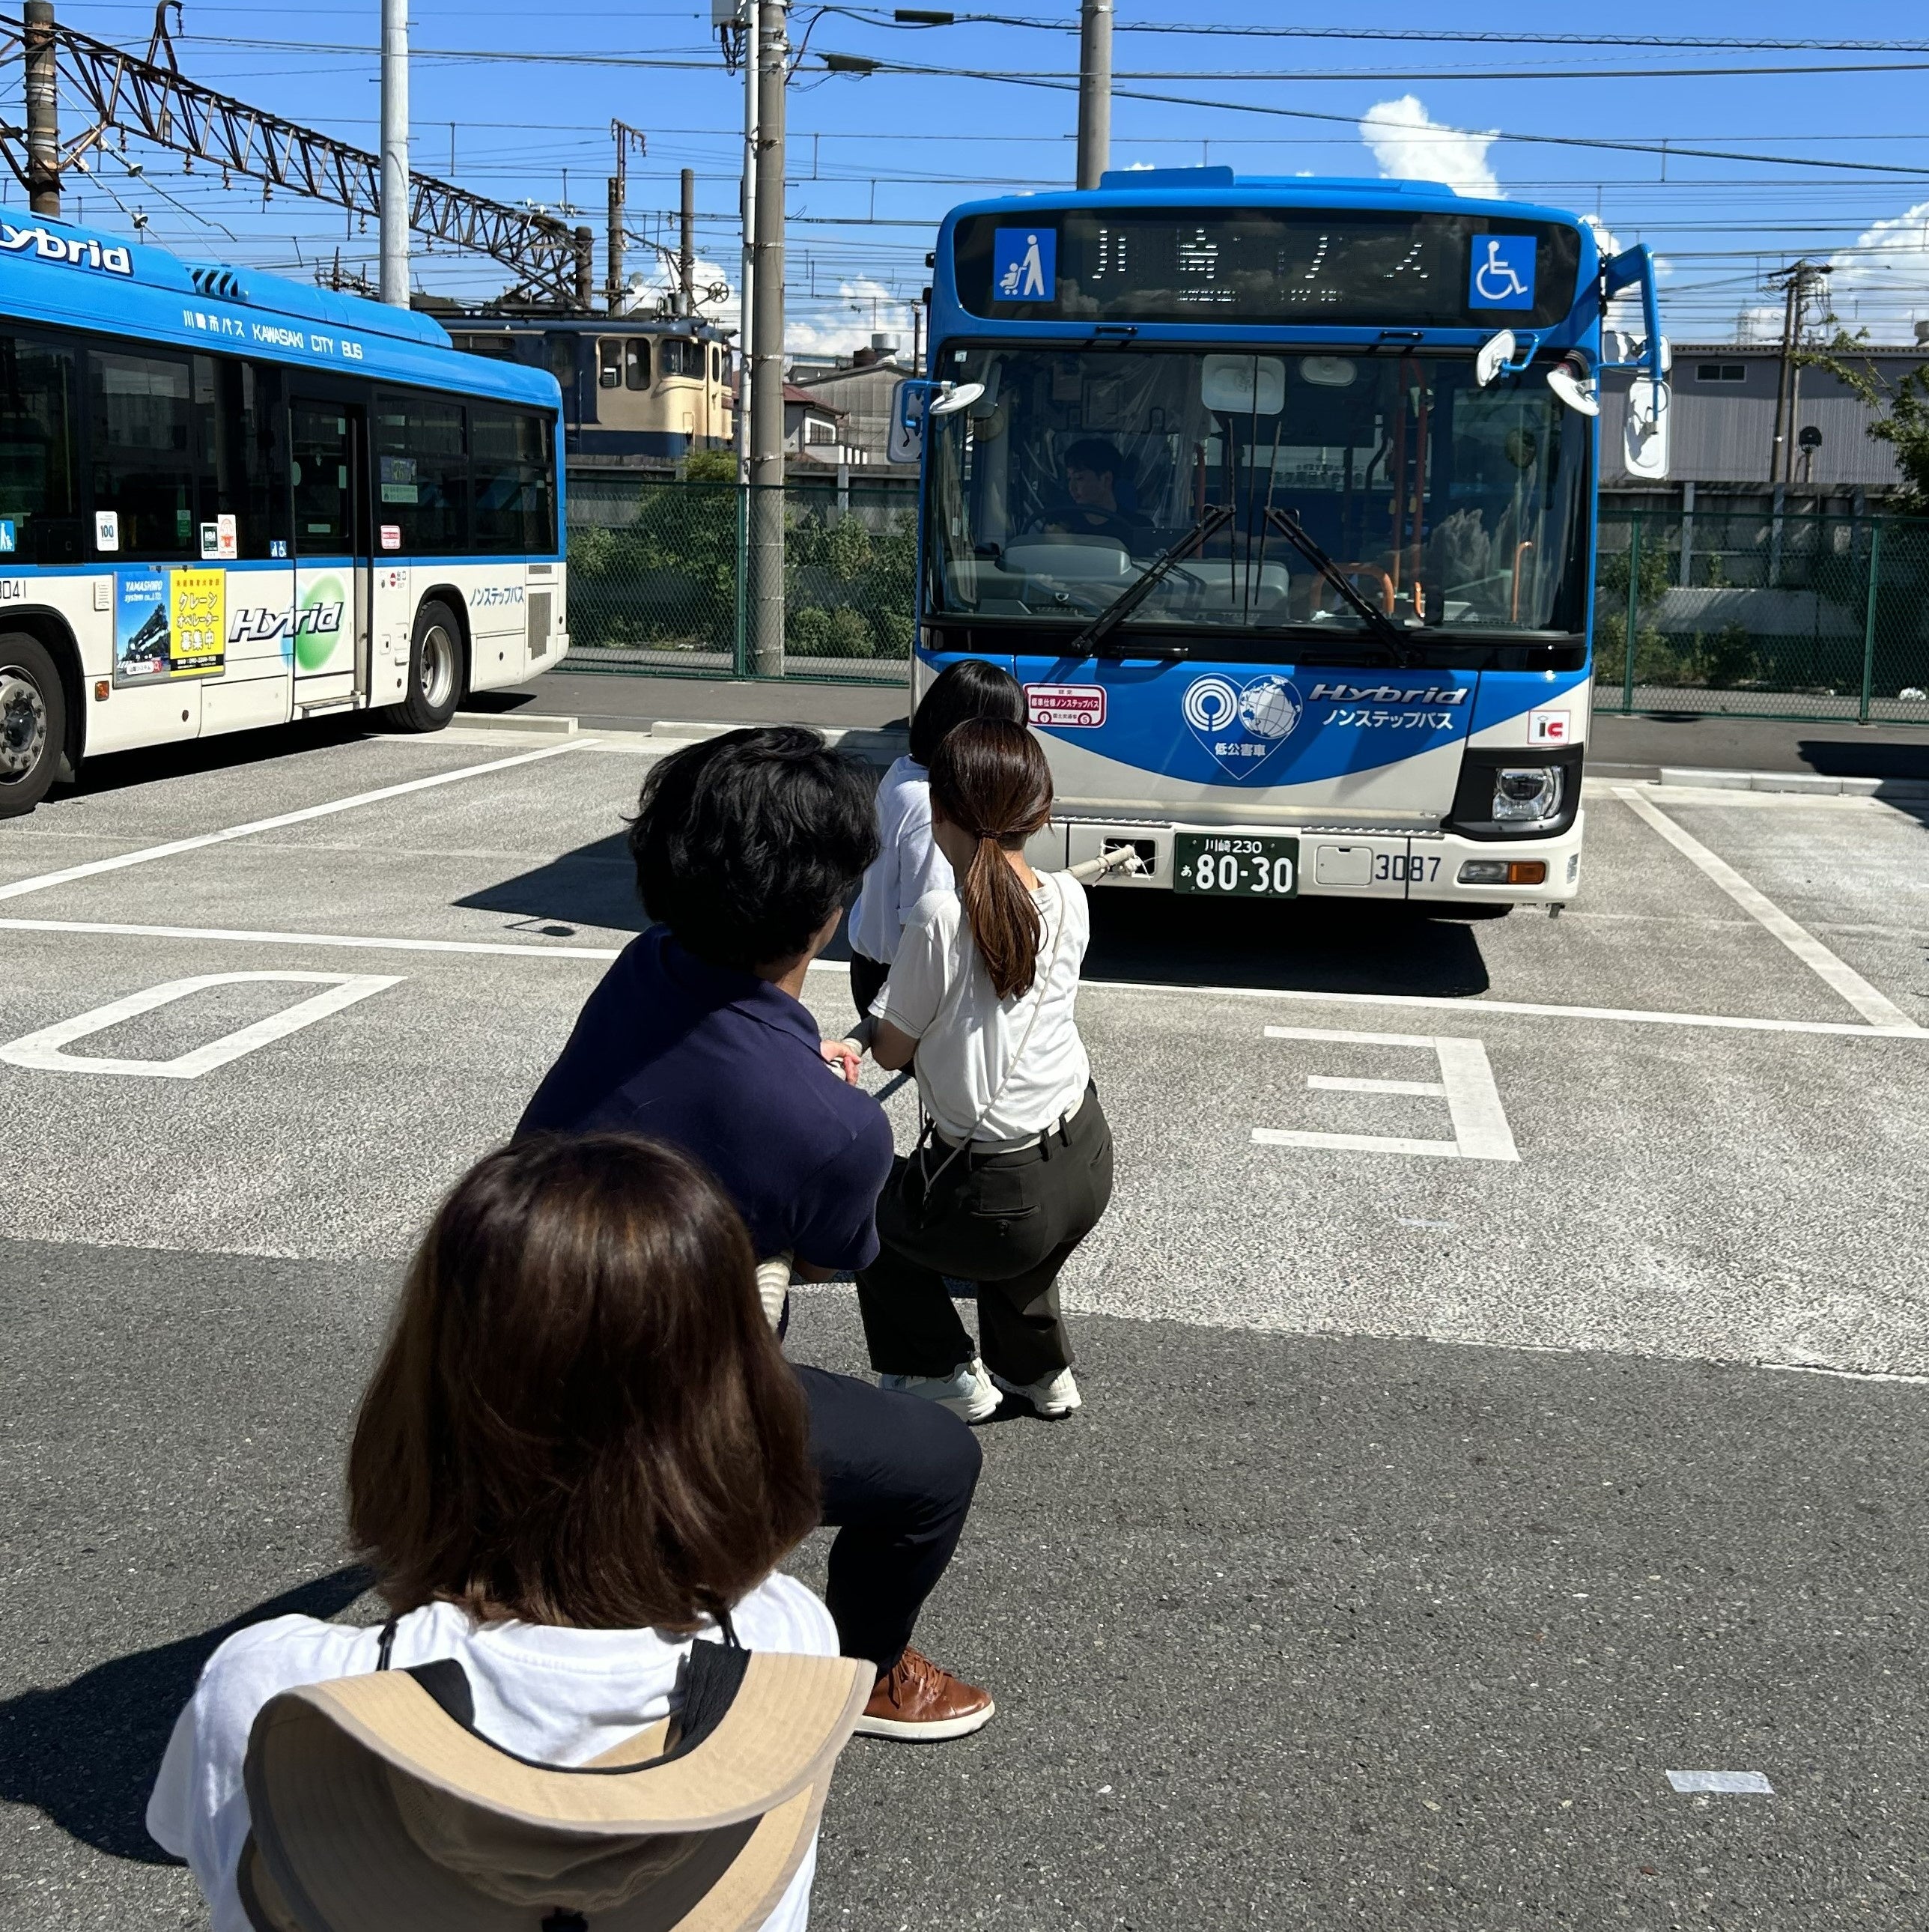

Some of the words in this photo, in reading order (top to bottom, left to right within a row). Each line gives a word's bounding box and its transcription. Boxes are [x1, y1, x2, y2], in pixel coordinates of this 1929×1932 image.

[0, 224, 133, 277] ybrid
[252, 323, 304, 349] KAWASAKI
[311, 335, 334, 354] CITY
[341, 340, 363, 360] BUS
[0, 580, 26, 599] 041
[126, 580, 162, 592] YAMASHIRO
[179, 592, 218, 612] クレーン
[1309, 684, 1471, 705] Hybrid
[1322, 710, 1453, 731] ノンステップバス
[1215, 742, 1266, 758] 低公害車
[1180, 864, 1192, 878] あ
[1196, 854, 1293, 893] 80-30
[1375, 854, 1442, 882] 3087
